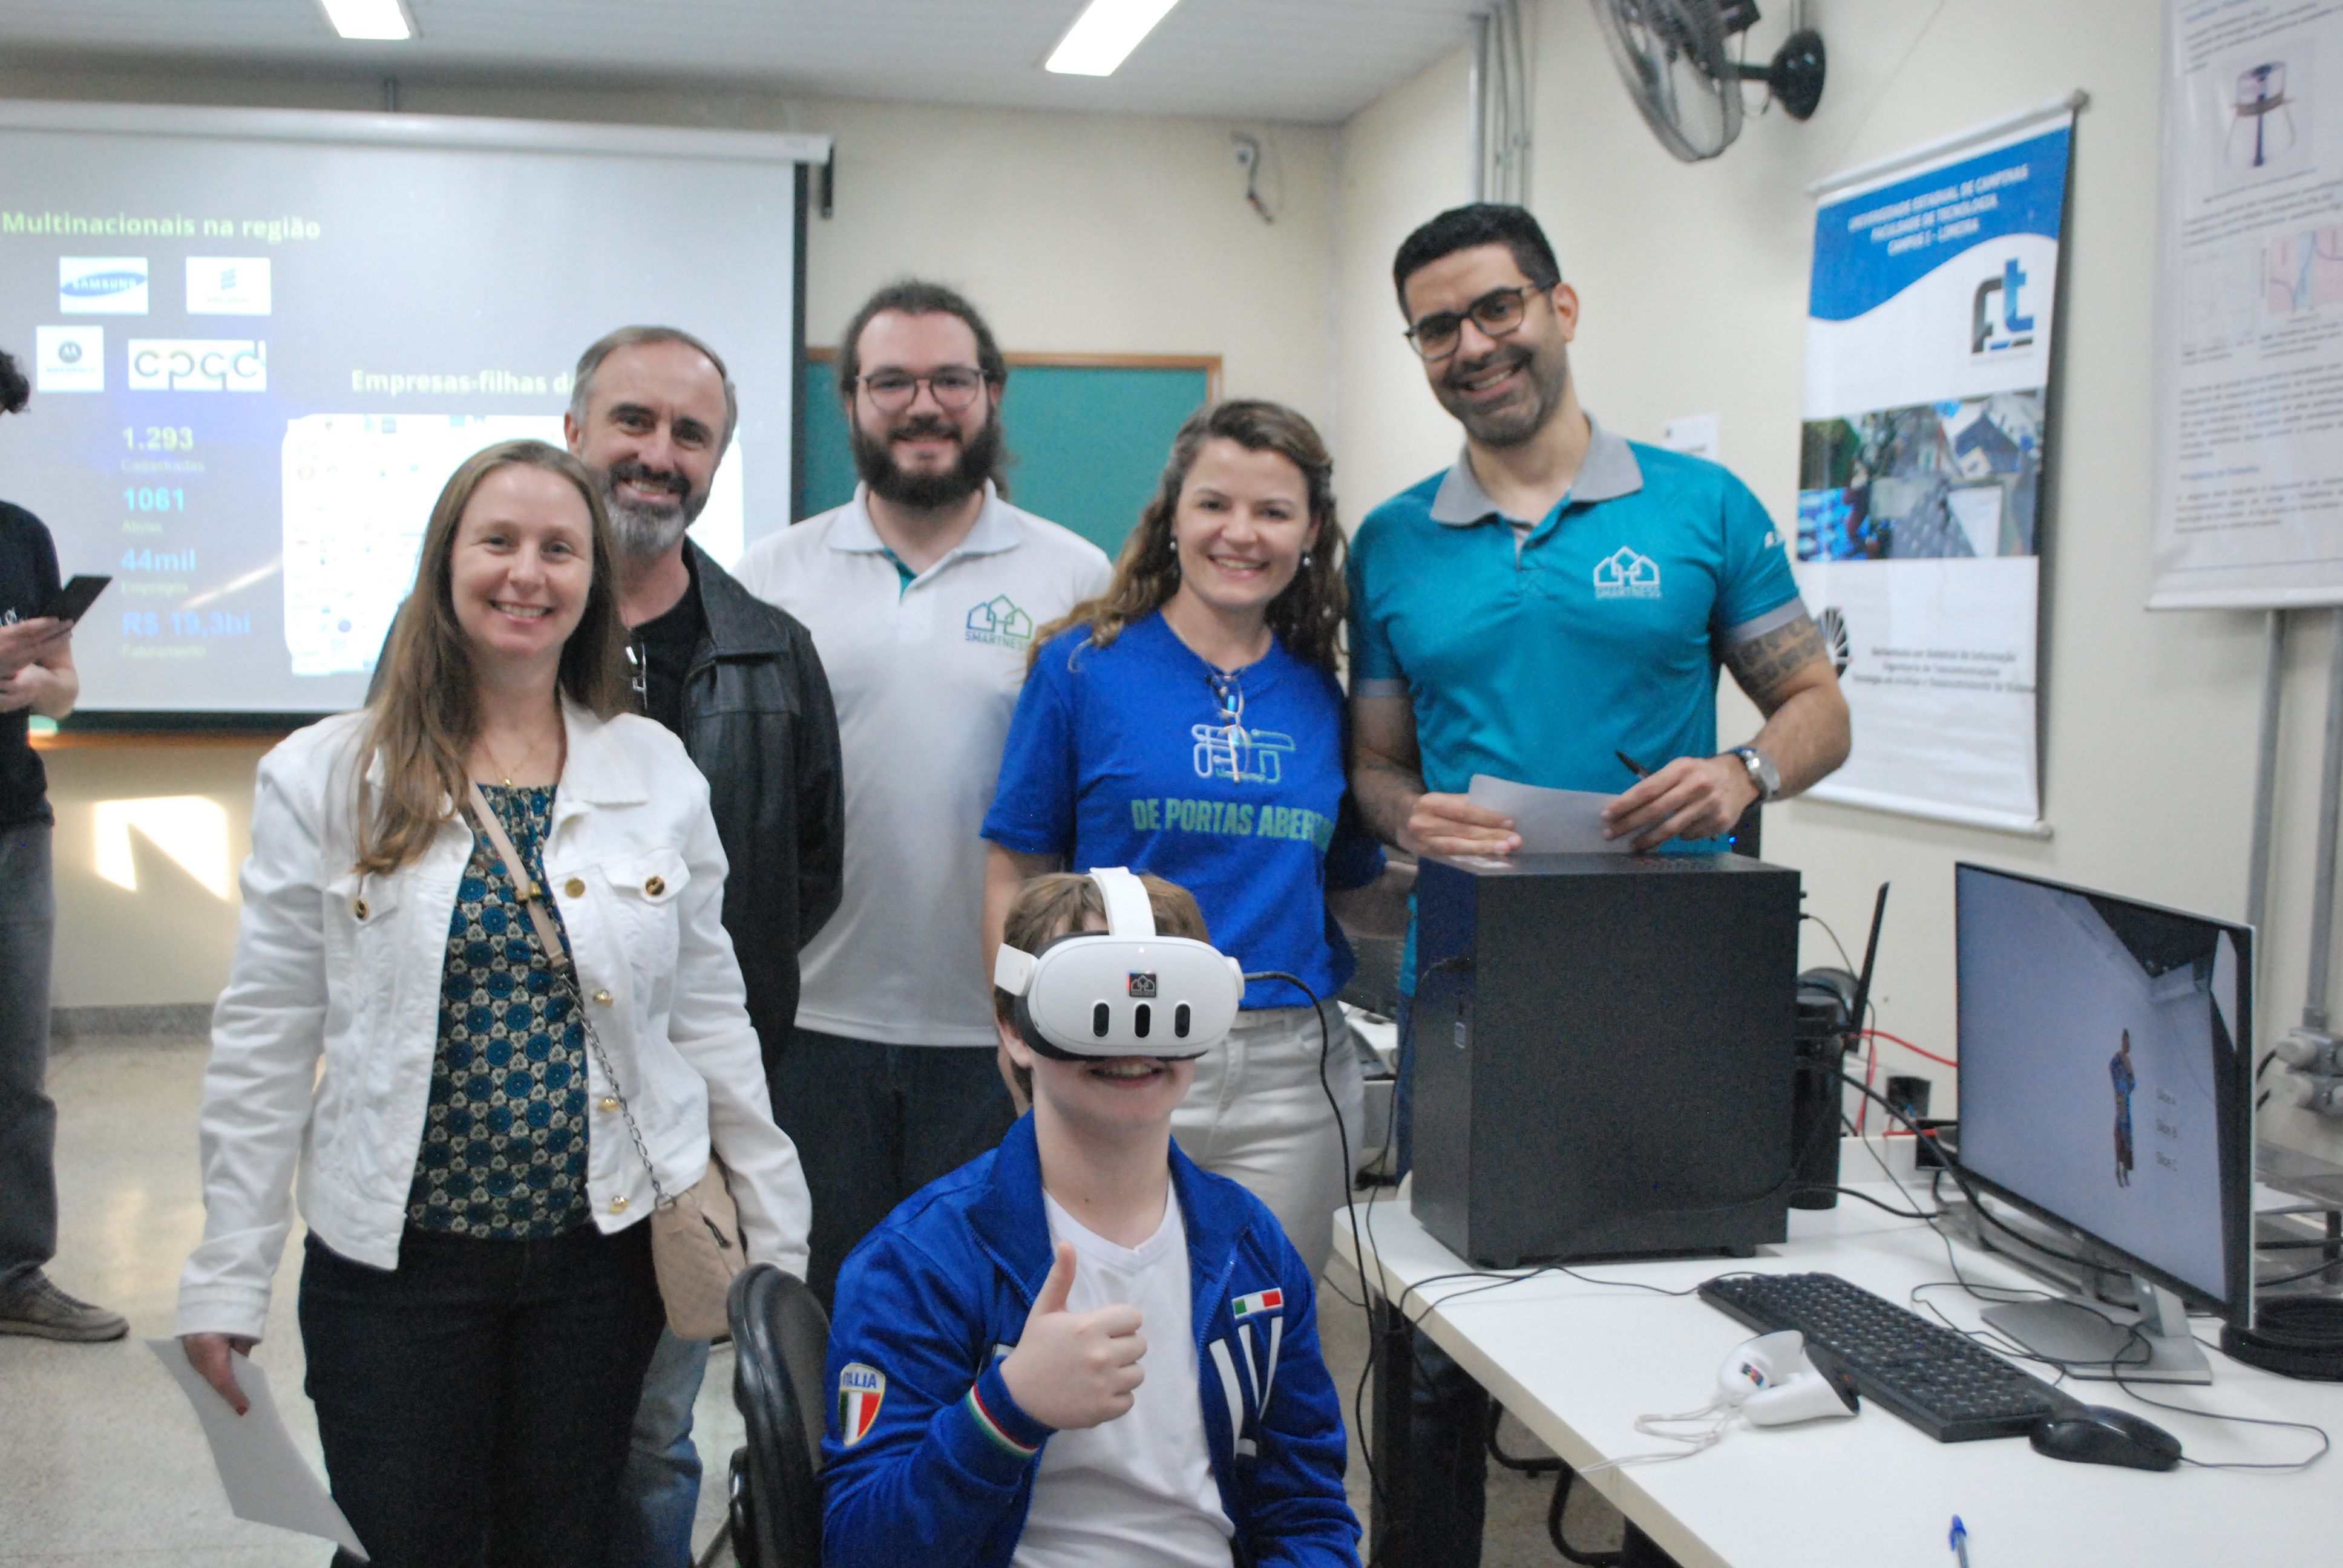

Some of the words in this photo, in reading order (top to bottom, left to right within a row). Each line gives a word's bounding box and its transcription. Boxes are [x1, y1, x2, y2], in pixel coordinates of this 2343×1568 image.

[2, 211, 195, 237] Multinacionais
[203, 218, 234, 238] na
[242, 215, 320, 245] região
[351, 369, 547, 397] Empresas-filhas
[123, 426, 194, 451] 1.293
[123, 486, 185, 512] 1061
[121, 547, 197, 572] 44mil
[122, 611, 160, 637] R$
[170, 610, 251, 638] 19,3bi
[1130, 798, 1162, 831] DE
[1164, 797, 1255, 835] PORTAS
